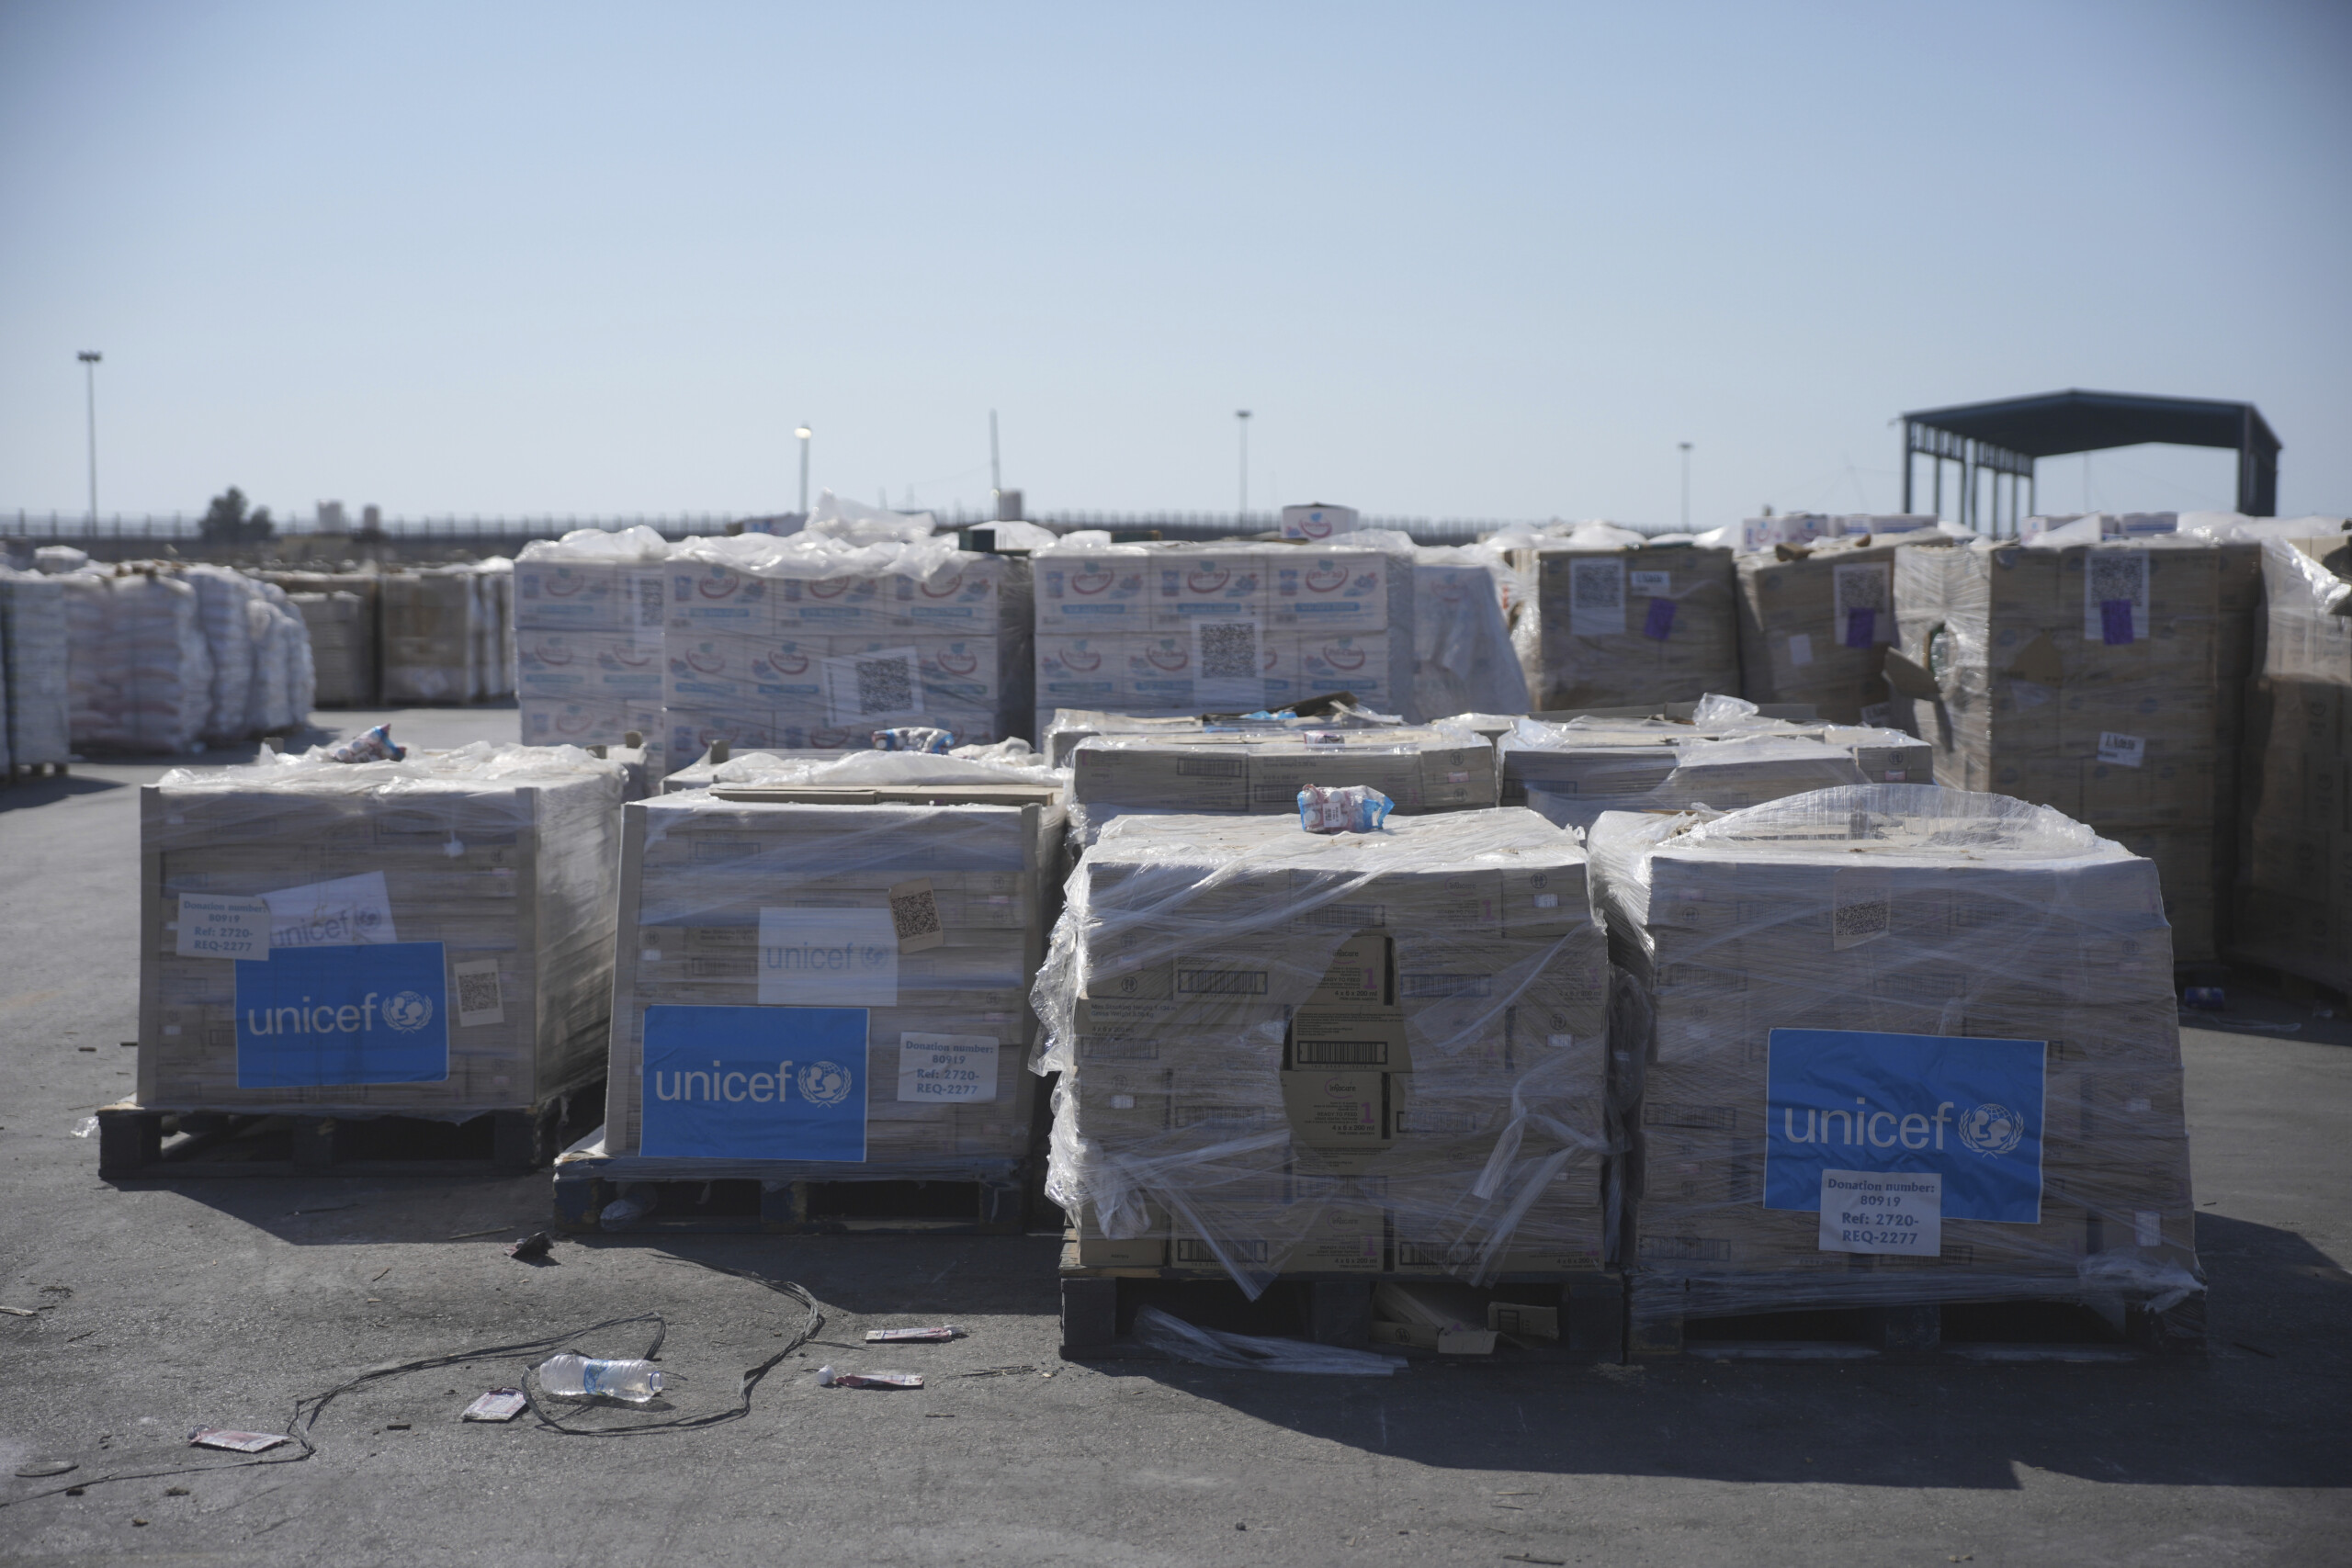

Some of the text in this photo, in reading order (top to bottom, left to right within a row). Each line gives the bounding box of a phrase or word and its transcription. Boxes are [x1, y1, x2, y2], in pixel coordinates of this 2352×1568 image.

[183, 900, 266, 913] Donation number:
[209, 914, 241, 923] 80919
[194, 926, 254, 938] Ref: 2720-
[270, 909, 349, 947] unicef
[194, 940, 253, 952] REQ-2277
[766, 942, 854, 970] unicef
[1363, 967, 1377, 989] 1
[248, 992, 378, 1036] unicef
[905, 1041, 994, 1054] Donation number:
[933, 1055, 966, 1065] 80919
[656, 1059, 794, 1102] unicef
[917, 1068, 979, 1080] Ref: 2720-
[917, 1083, 978, 1095] REQ-2277
[1361, 1101, 1375, 1124] 1
[1784, 1097, 1954, 1150] unicef
[1827, 1179, 1935, 1192] Donation number:
[1860, 1195, 1901, 1207] 80919
[1842, 1212, 1919, 1227] Ref: 2720-
[1842, 1230, 1918, 1245] REQ-2277
[1363, 1234, 1378, 1257] 1
